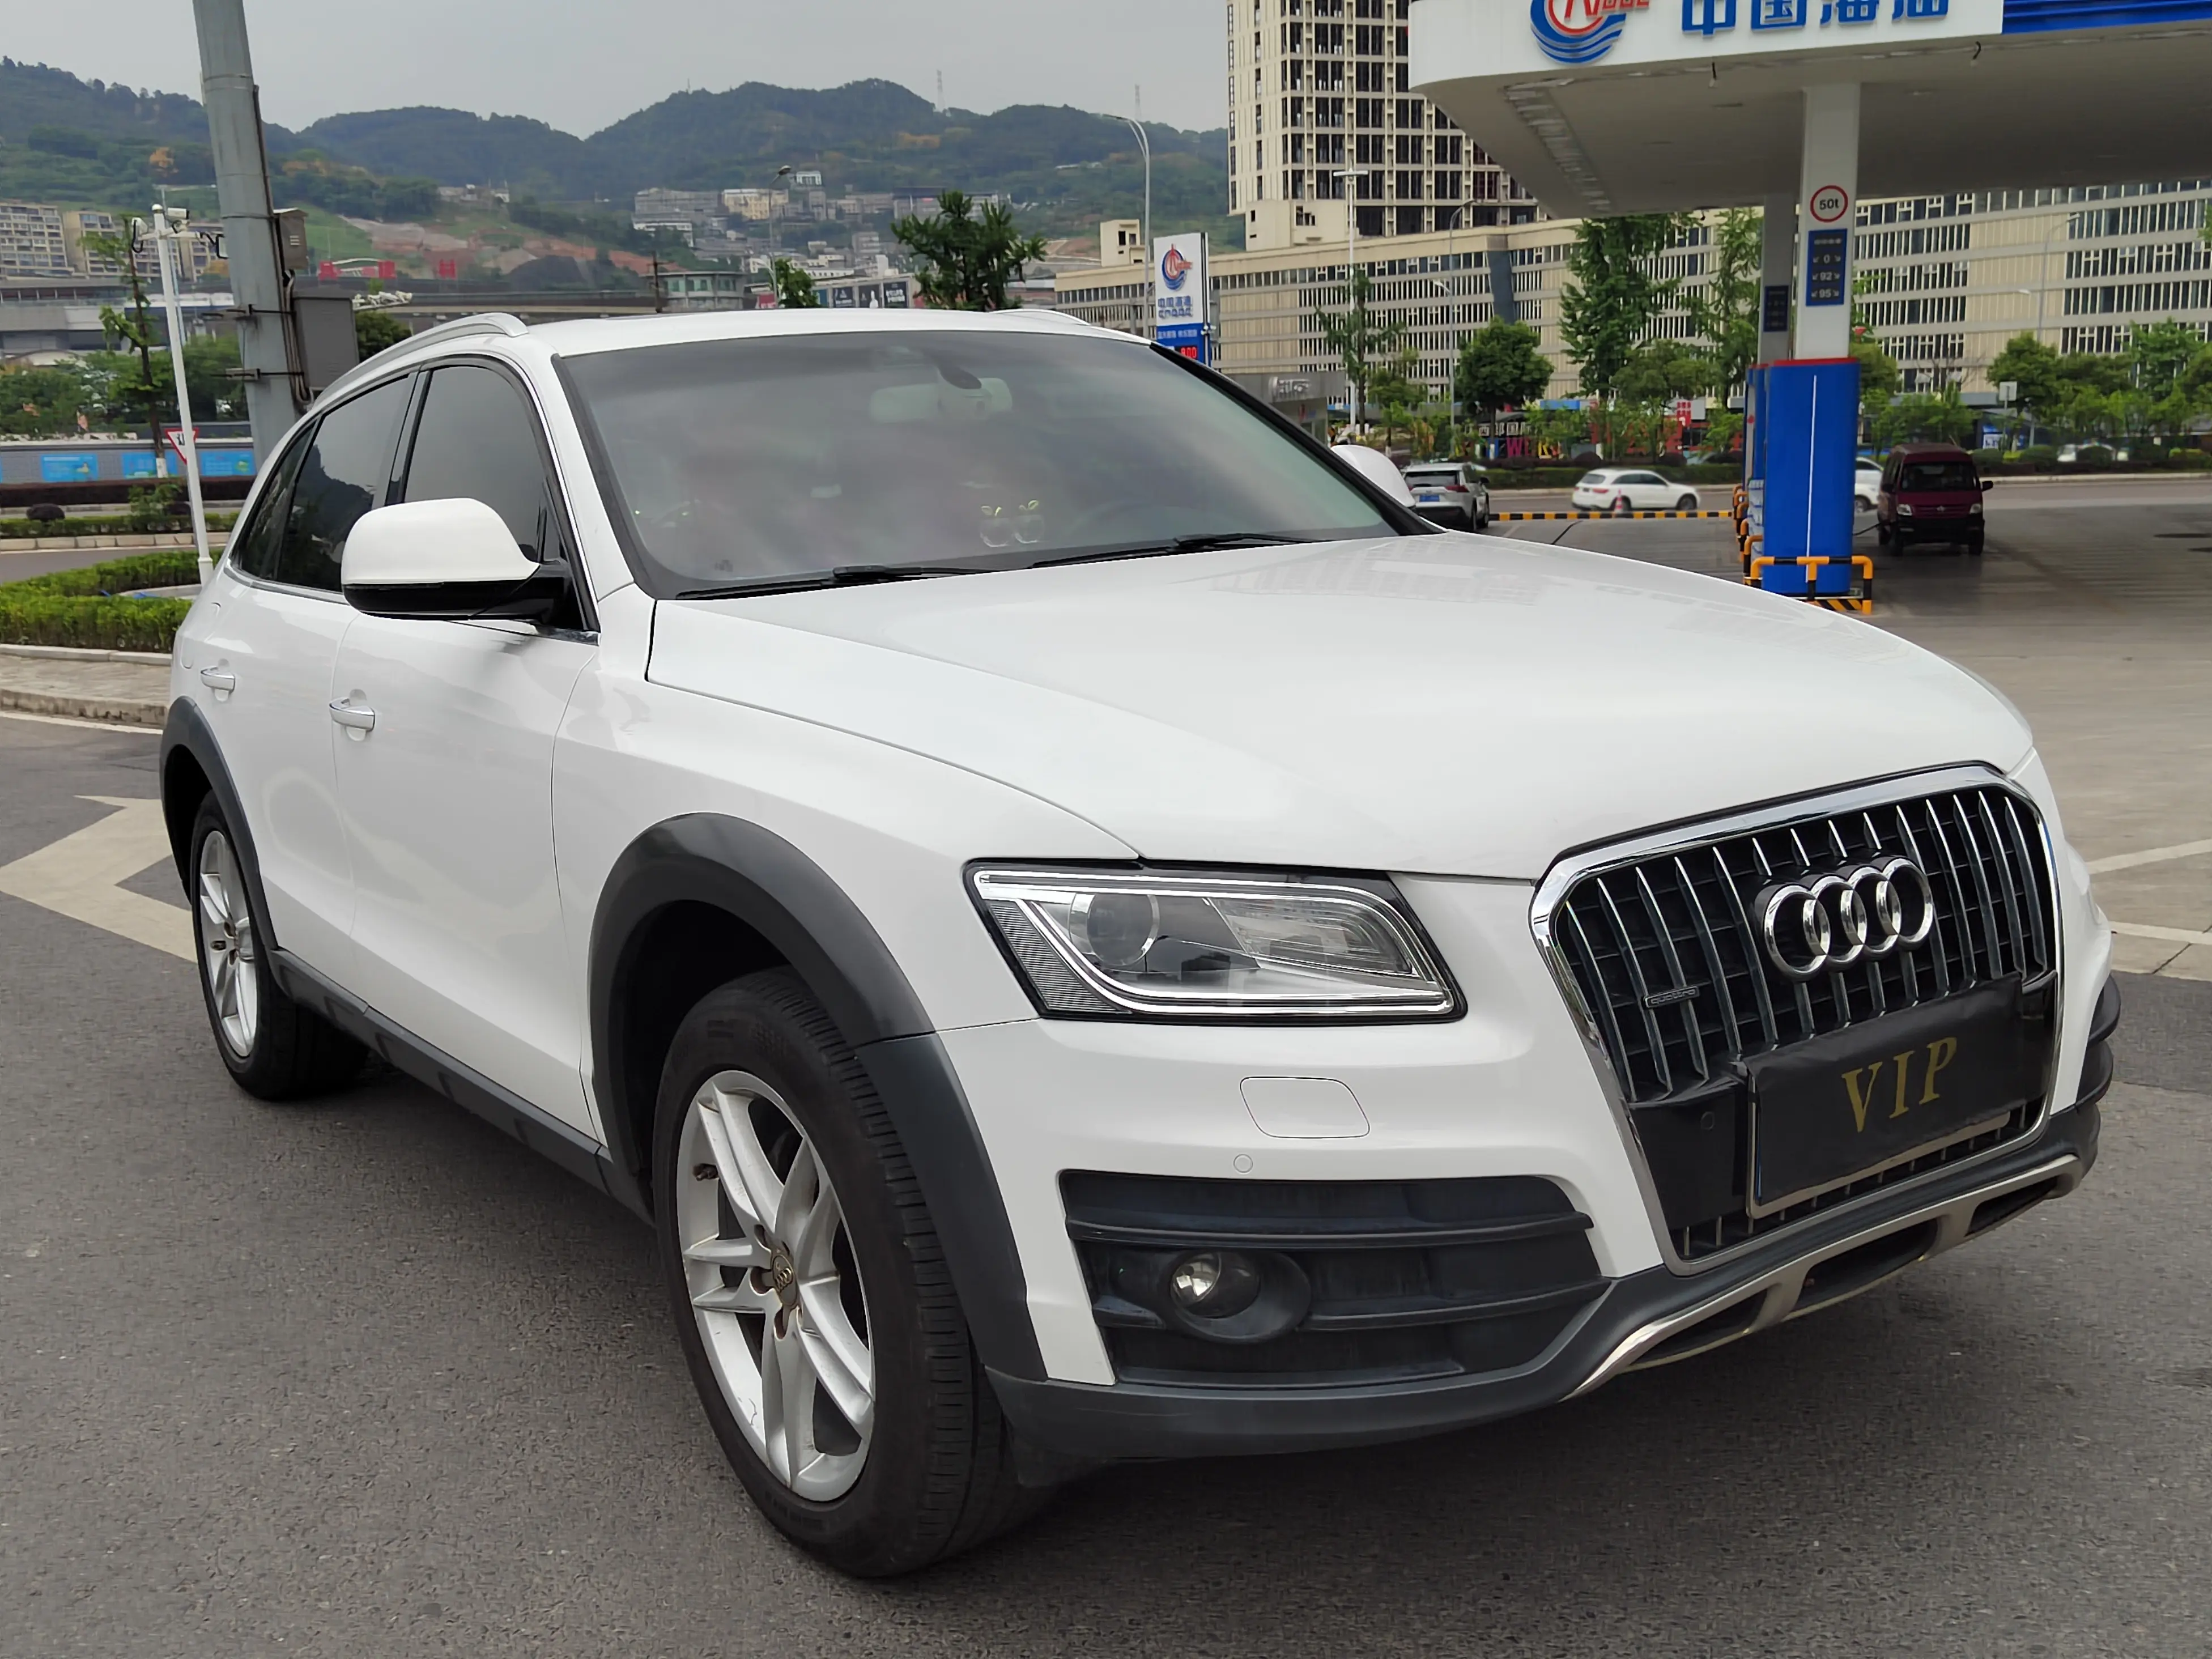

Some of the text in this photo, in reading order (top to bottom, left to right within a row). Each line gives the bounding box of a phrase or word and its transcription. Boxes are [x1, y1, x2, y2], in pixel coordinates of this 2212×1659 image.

[1819, 198, 1839, 210] 50t
[1823, 255, 1830, 264] 0
[1820, 271, 1832, 281] 92
[1651, 989, 1696, 1005] quattro
[1841, 1036, 1958, 1133] VIP
